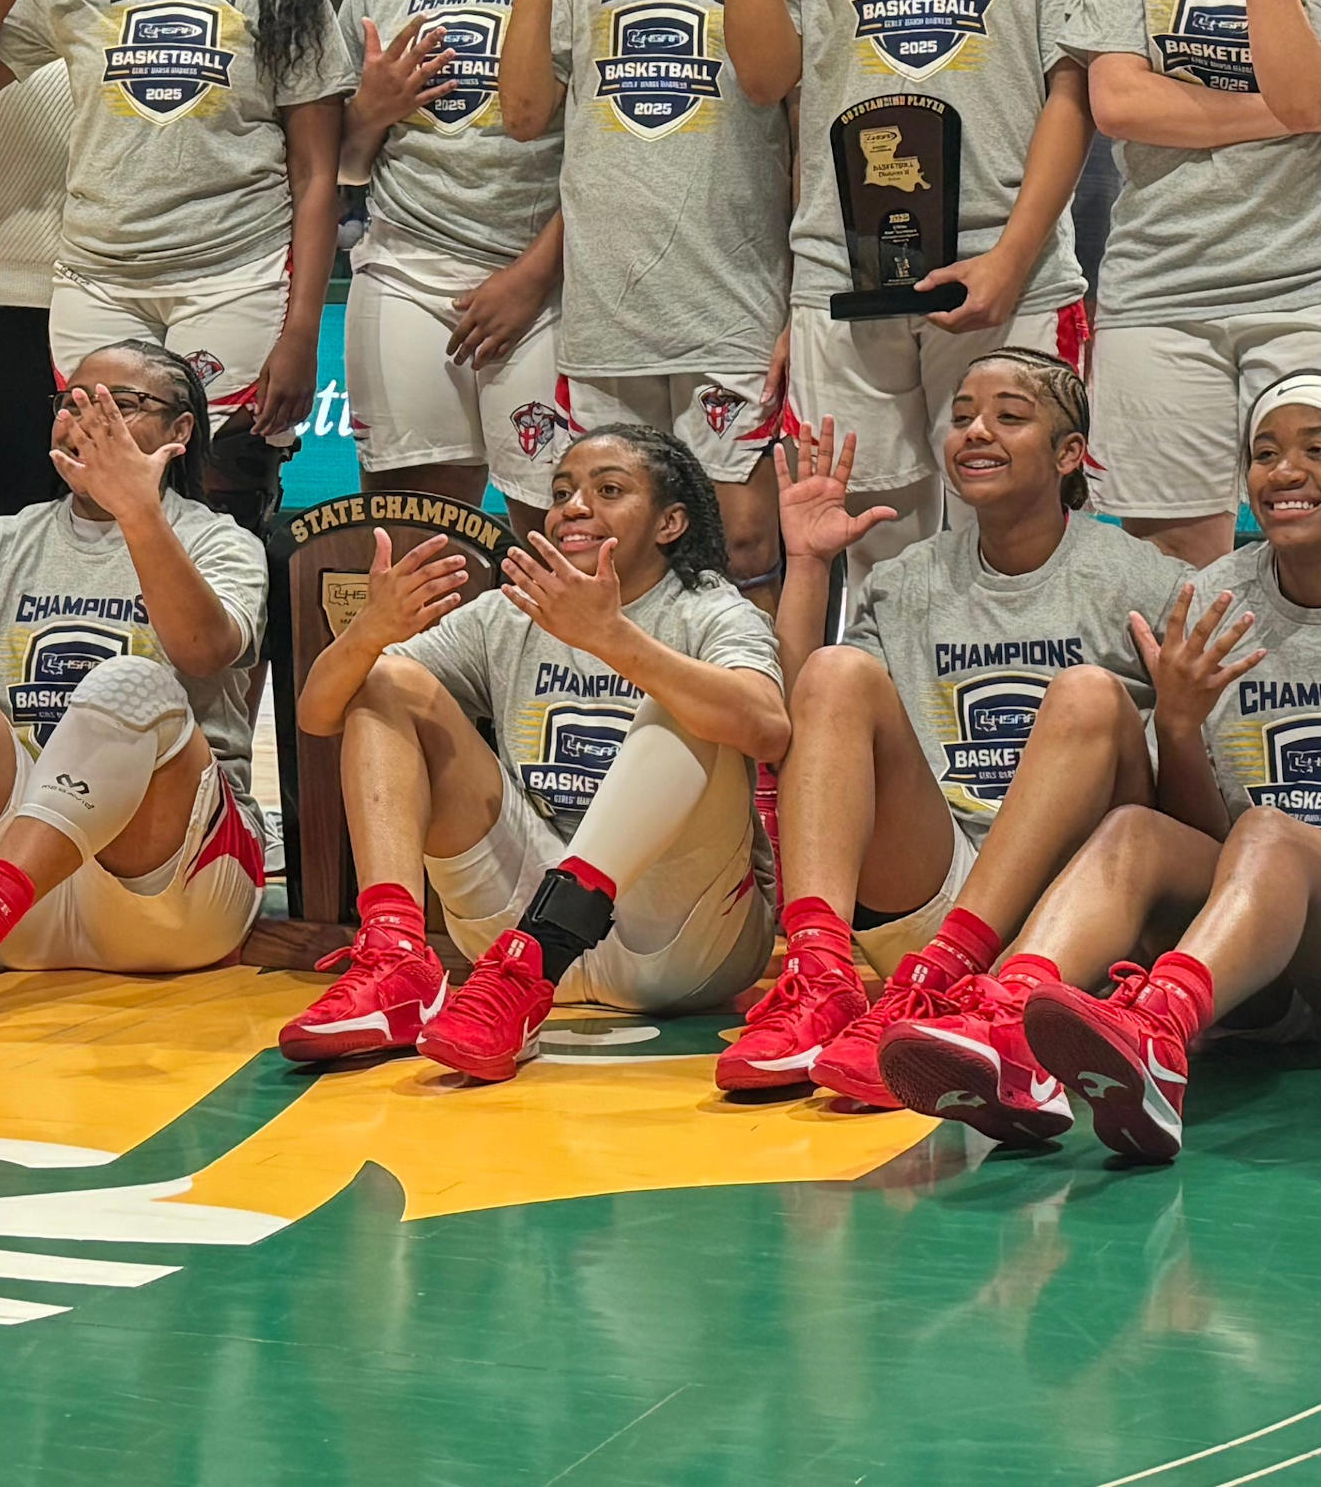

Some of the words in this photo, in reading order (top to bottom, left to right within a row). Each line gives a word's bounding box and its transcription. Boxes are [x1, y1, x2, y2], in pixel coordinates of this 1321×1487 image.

[899, 39, 938, 56] 2025
[1165, 39, 1253, 64] BASKETB
[111, 50, 224, 70] BASKETBALL
[605, 62, 713, 81] BASKETBALL
[1209, 74, 1249, 92] 2025
[145, 87, 183, 101] 2025
[435, 98, 466, 112] 2025
[634, 101, 673, 115] 2025
[841, 95, 906, 125] OUTSTANDING
[906, 95, 946, 115] PLAYER
[290, 497, 365, 543] STATE
[370, 494, 502, 551] CHAMPION
[15, 593, 150, 625] CHAMPIONS
[935, 637, 1085, 677] CHAMPIONS
